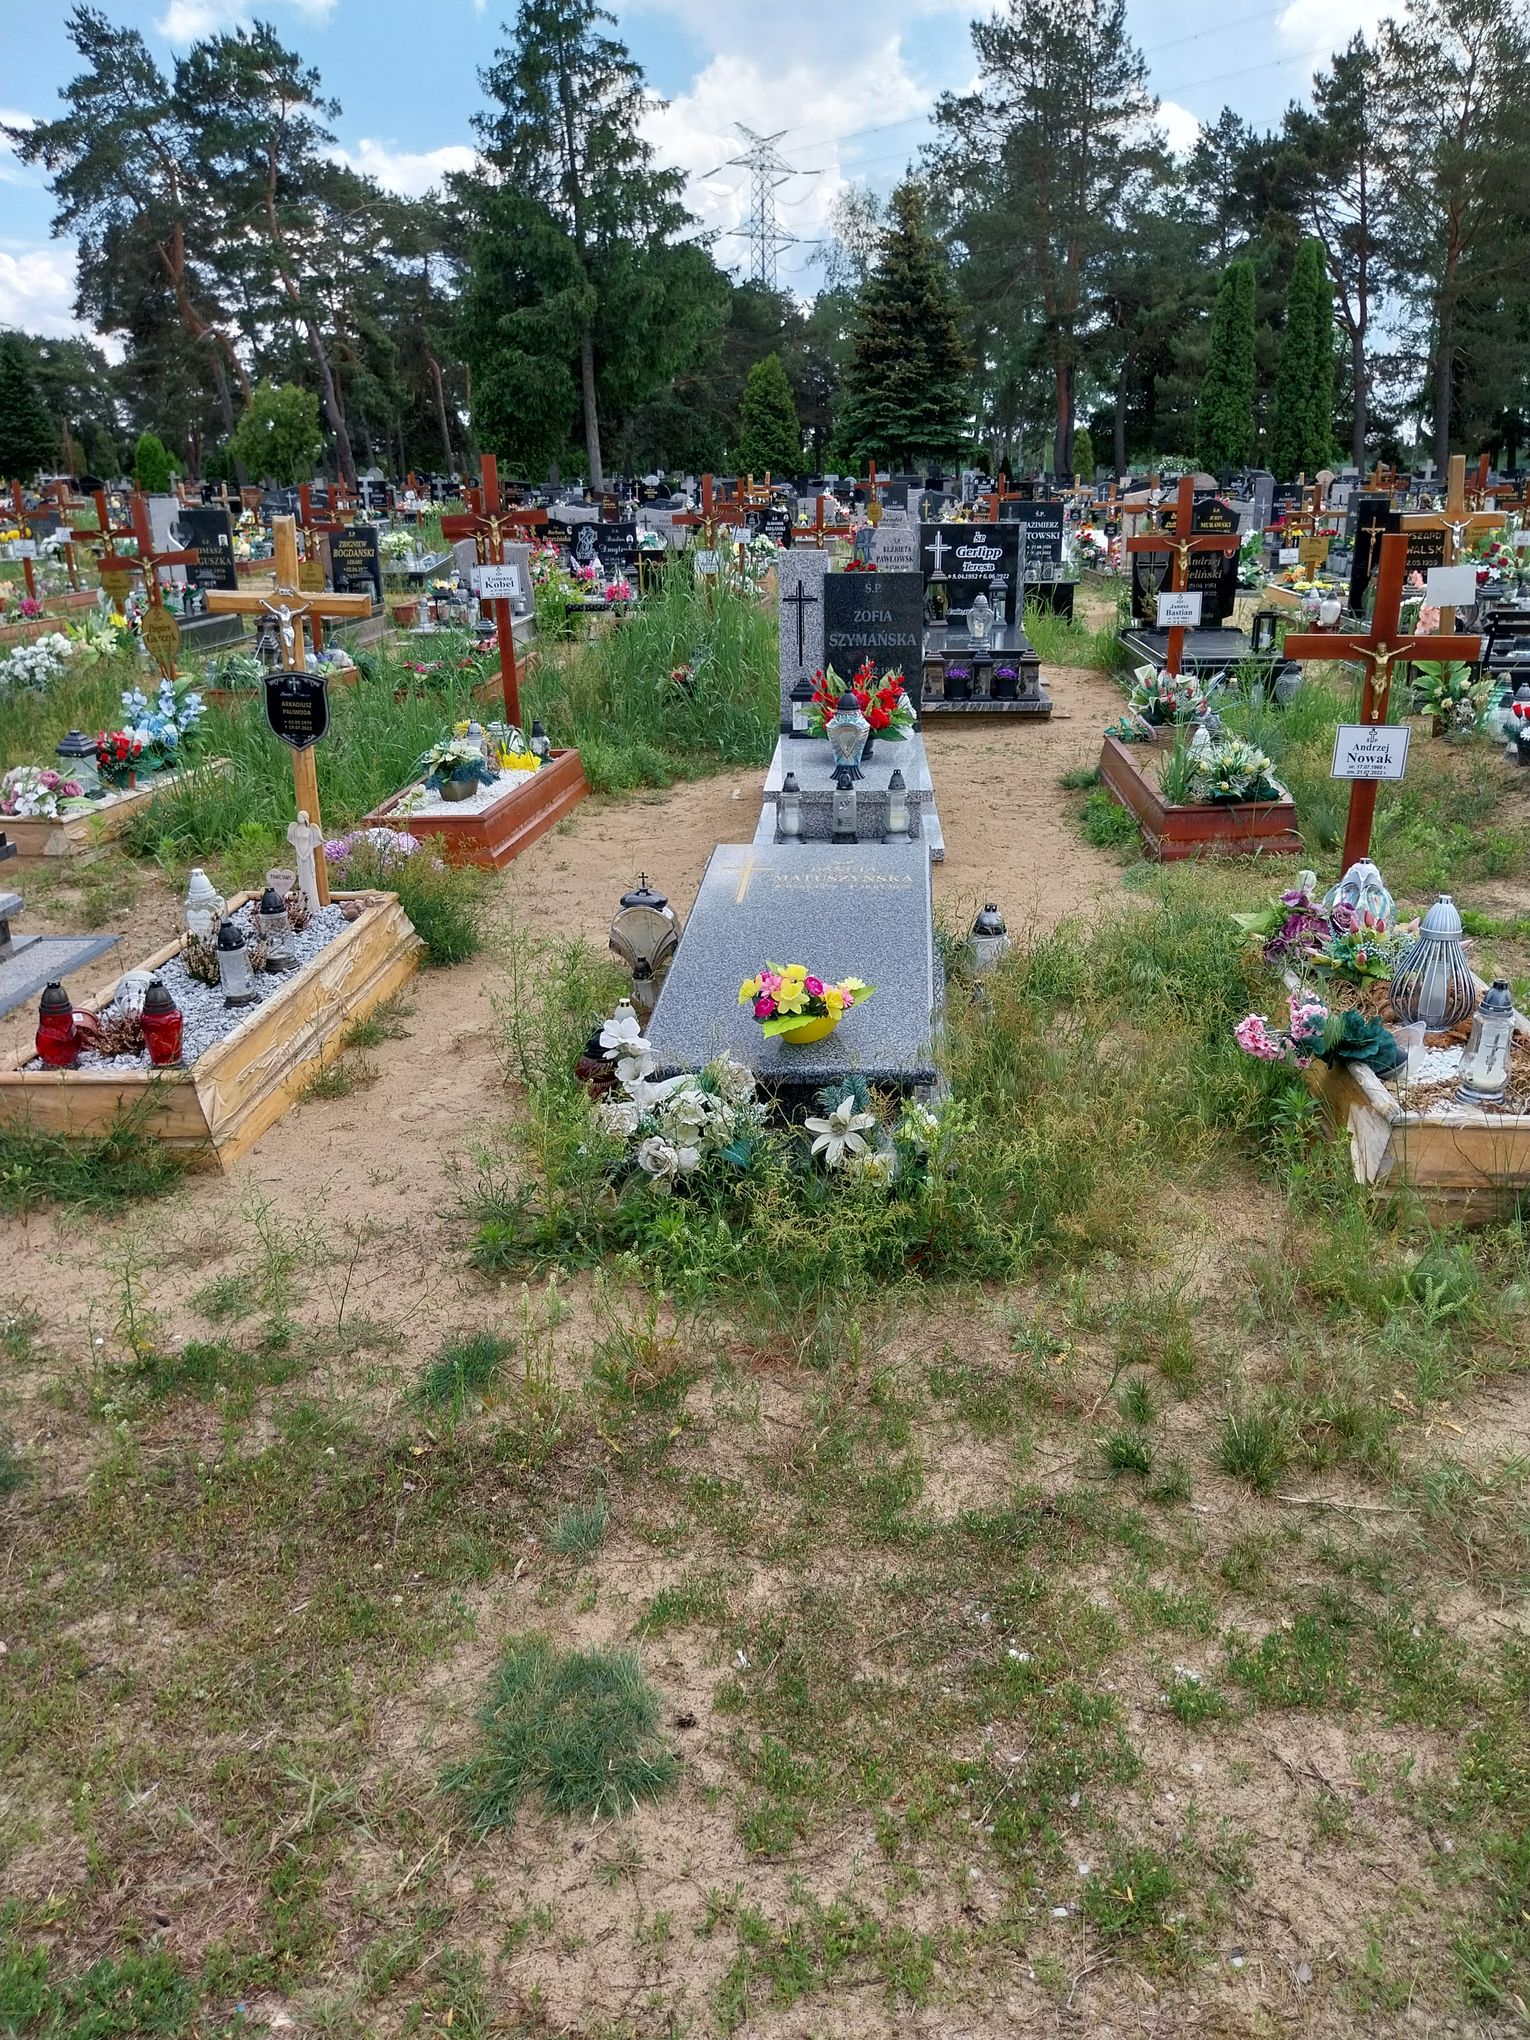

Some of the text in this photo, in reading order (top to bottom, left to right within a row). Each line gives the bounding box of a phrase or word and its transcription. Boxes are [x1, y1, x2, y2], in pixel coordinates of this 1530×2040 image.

[1026, 521, 1060, 529] AZIMIERZ
[1025, 531, 1061, 540] TOWSKI
[339, 540, 368, 548] ZBIGNIEW
[956, 545, 1003, 560] Gerlipp
[876, 555, 914, 563] PAWŁOWSK
[962, 561, 996, 572] Teresa
[1187, 567, 1223, 579] ieliński
[485, 580, 514, 589] Kobel
[865, 581, 882, 594] Ś.P.
[853, 610, 893, 622] ZOFIA
[1166, 609, 1193, 617] Bastian
[829, 630, 917, 647] SZYMAŃSKA
[281, 701, 312, 709] ARKADIUSZ
[282, 708, 312, 716] PALIWODA
[1352, 743, 1390, 754] Andrzej
[1346, 752, 1393, 764] Nowak
